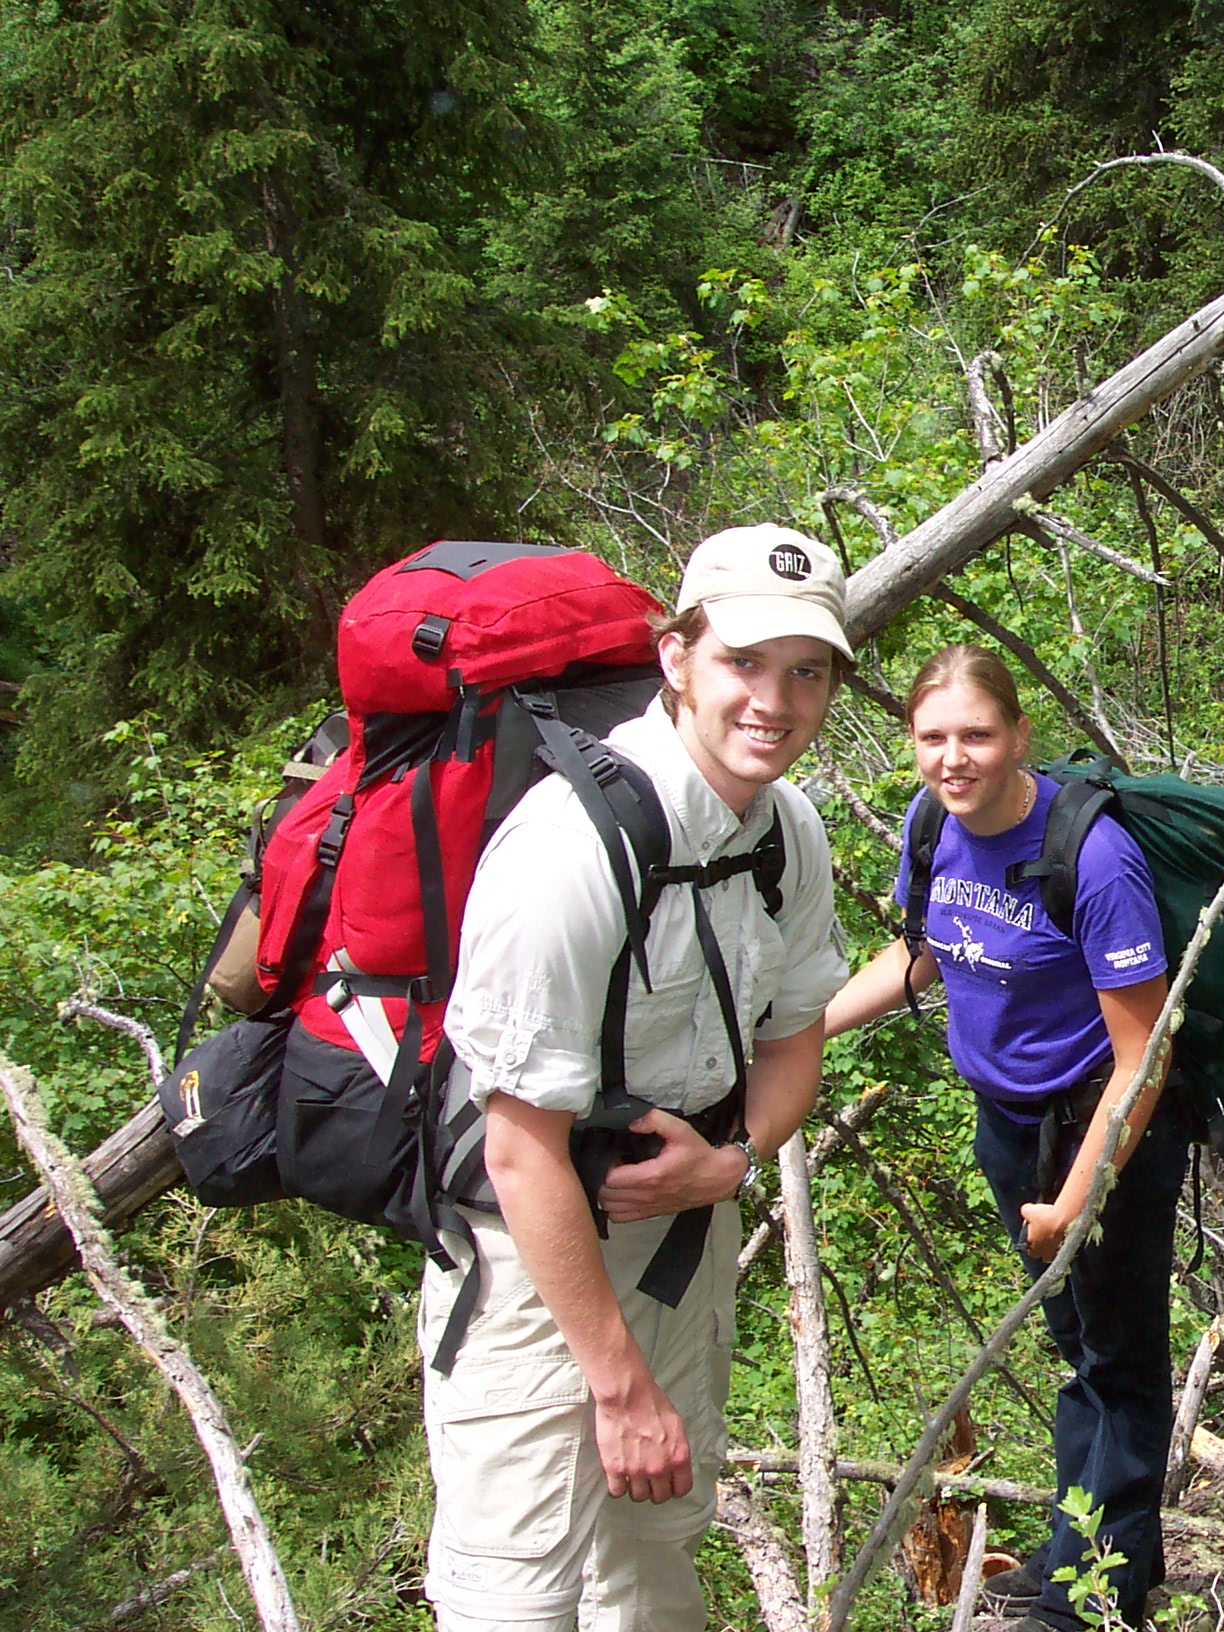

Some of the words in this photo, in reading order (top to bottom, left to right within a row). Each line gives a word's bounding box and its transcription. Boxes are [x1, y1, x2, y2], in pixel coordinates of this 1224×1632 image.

[769, 551, 812, 577] GRIZ
[929, 876, 1034, 931] MONTANA
[1104, 948, 1136, 961] VIRGINIA
[1136, 942, 1151, 954] CITY
[1113, 953, 1149, 969] MONTANA
